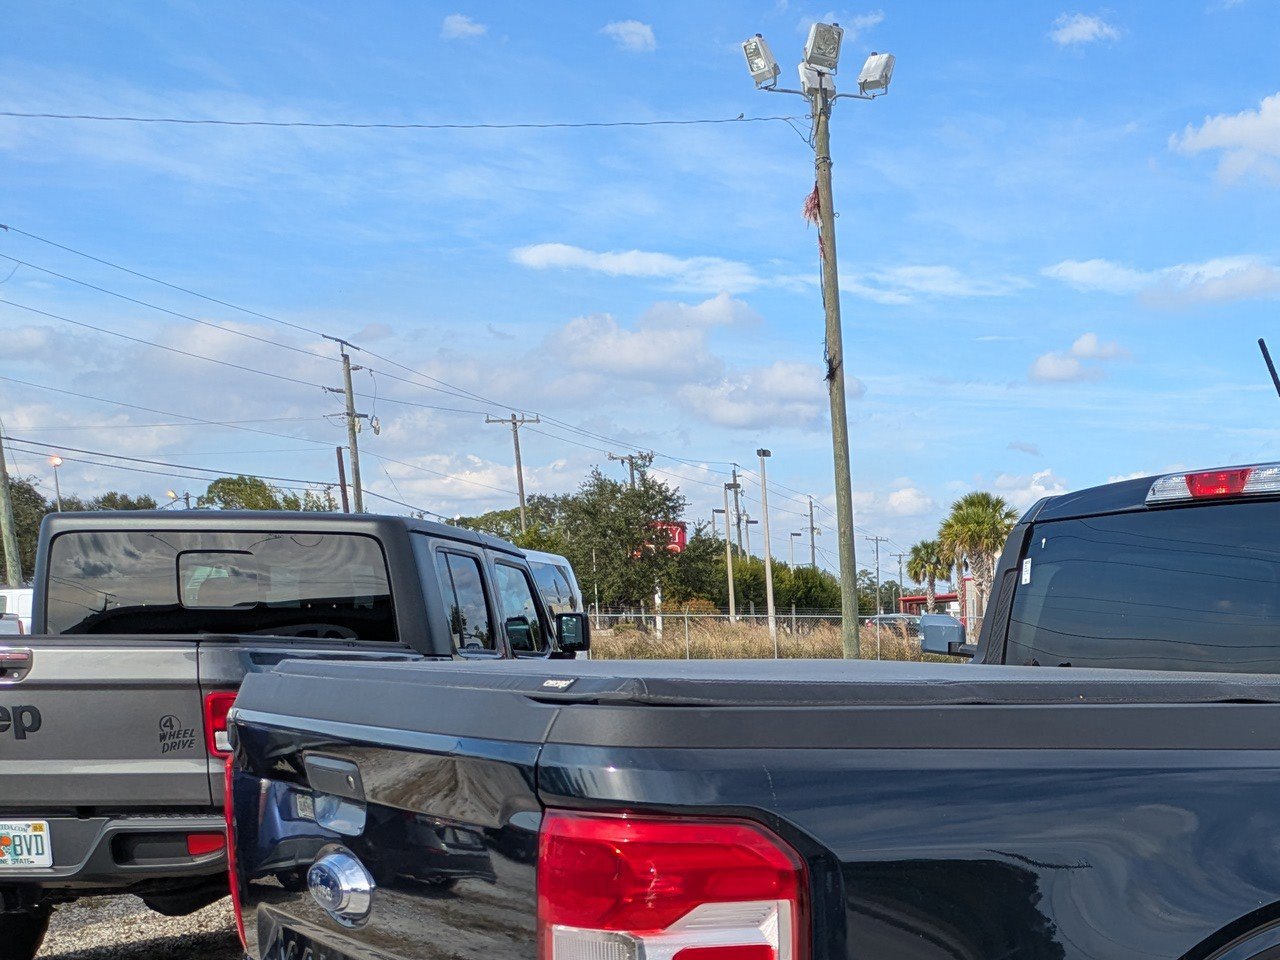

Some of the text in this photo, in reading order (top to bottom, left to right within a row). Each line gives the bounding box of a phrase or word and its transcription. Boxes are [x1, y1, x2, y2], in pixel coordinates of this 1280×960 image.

[162, 716, 174, 730] 4
[159, 729, 195, 743] WHEEL
[162, 739, 196, 754] DRIVE
[12, 834, 45, 856] BVD
